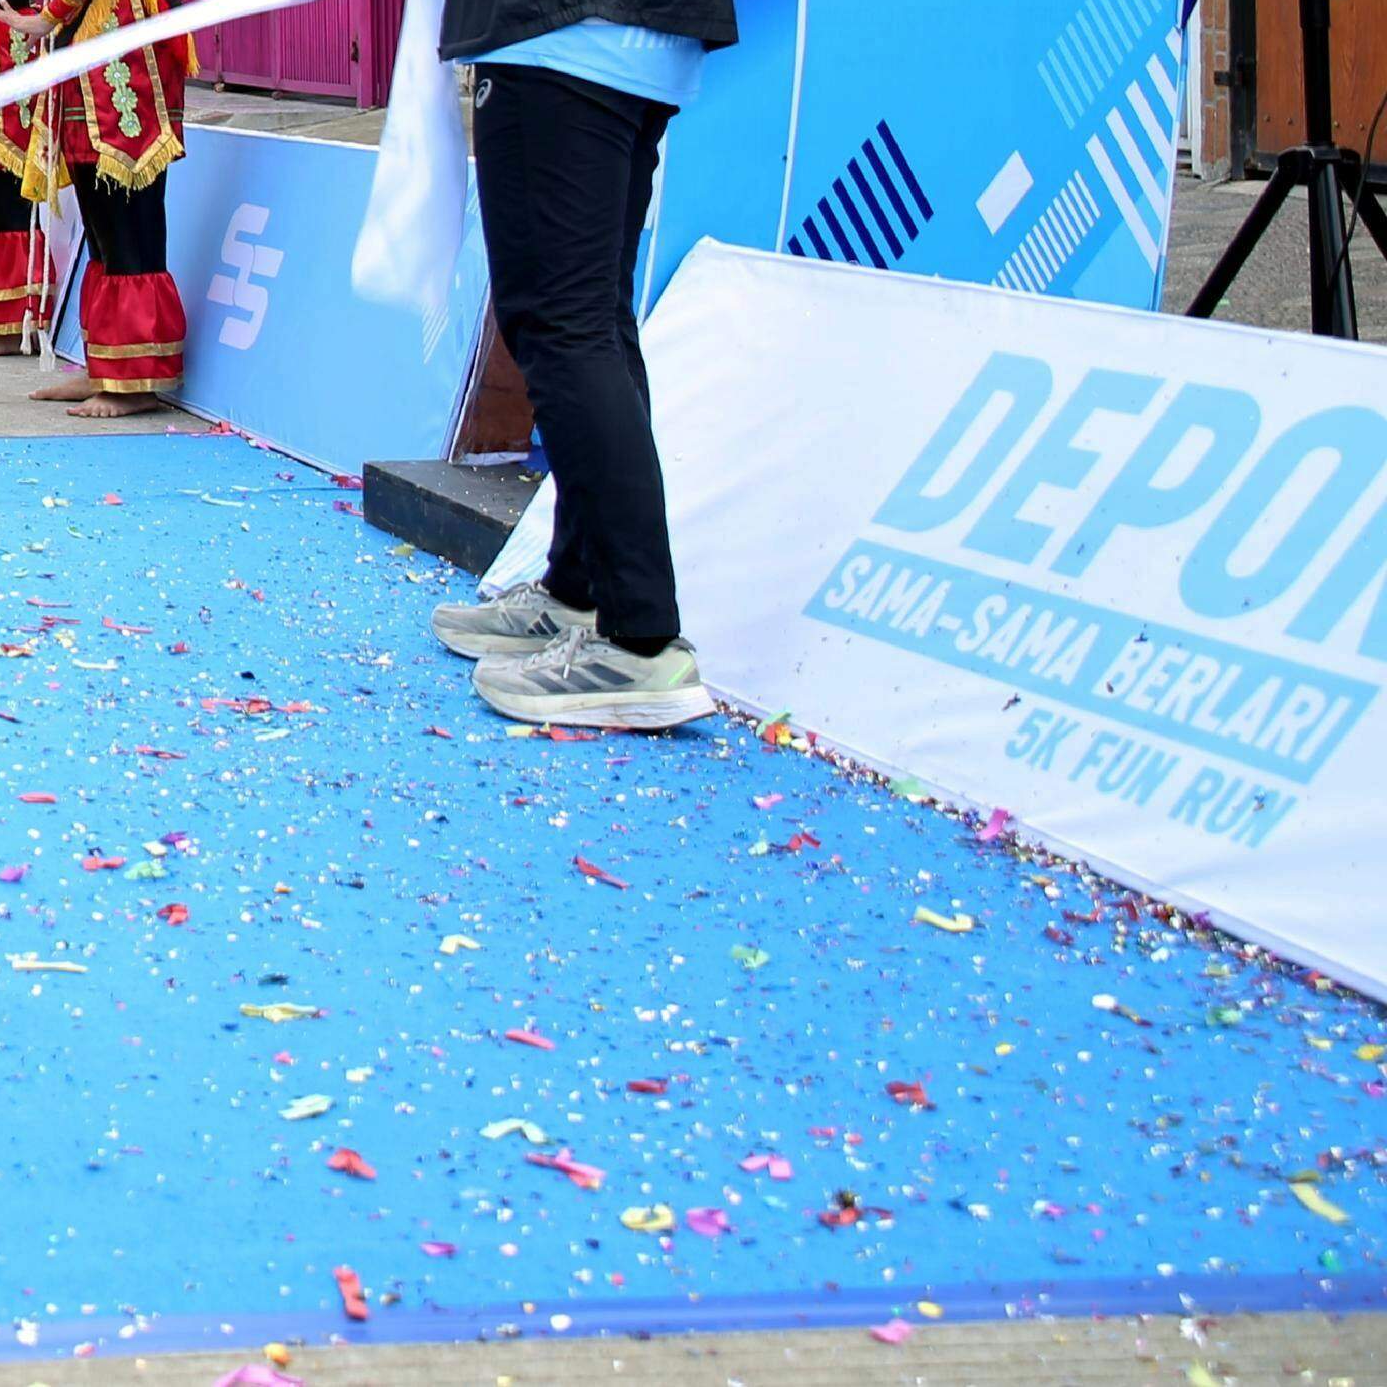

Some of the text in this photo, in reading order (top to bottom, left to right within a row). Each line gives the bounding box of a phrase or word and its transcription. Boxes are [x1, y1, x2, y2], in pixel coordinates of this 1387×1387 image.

[824, 555, 1352, 763] SAMA-SAMA BERLARI
[1004, 708, 1299, 850] 5K FUN RUN
